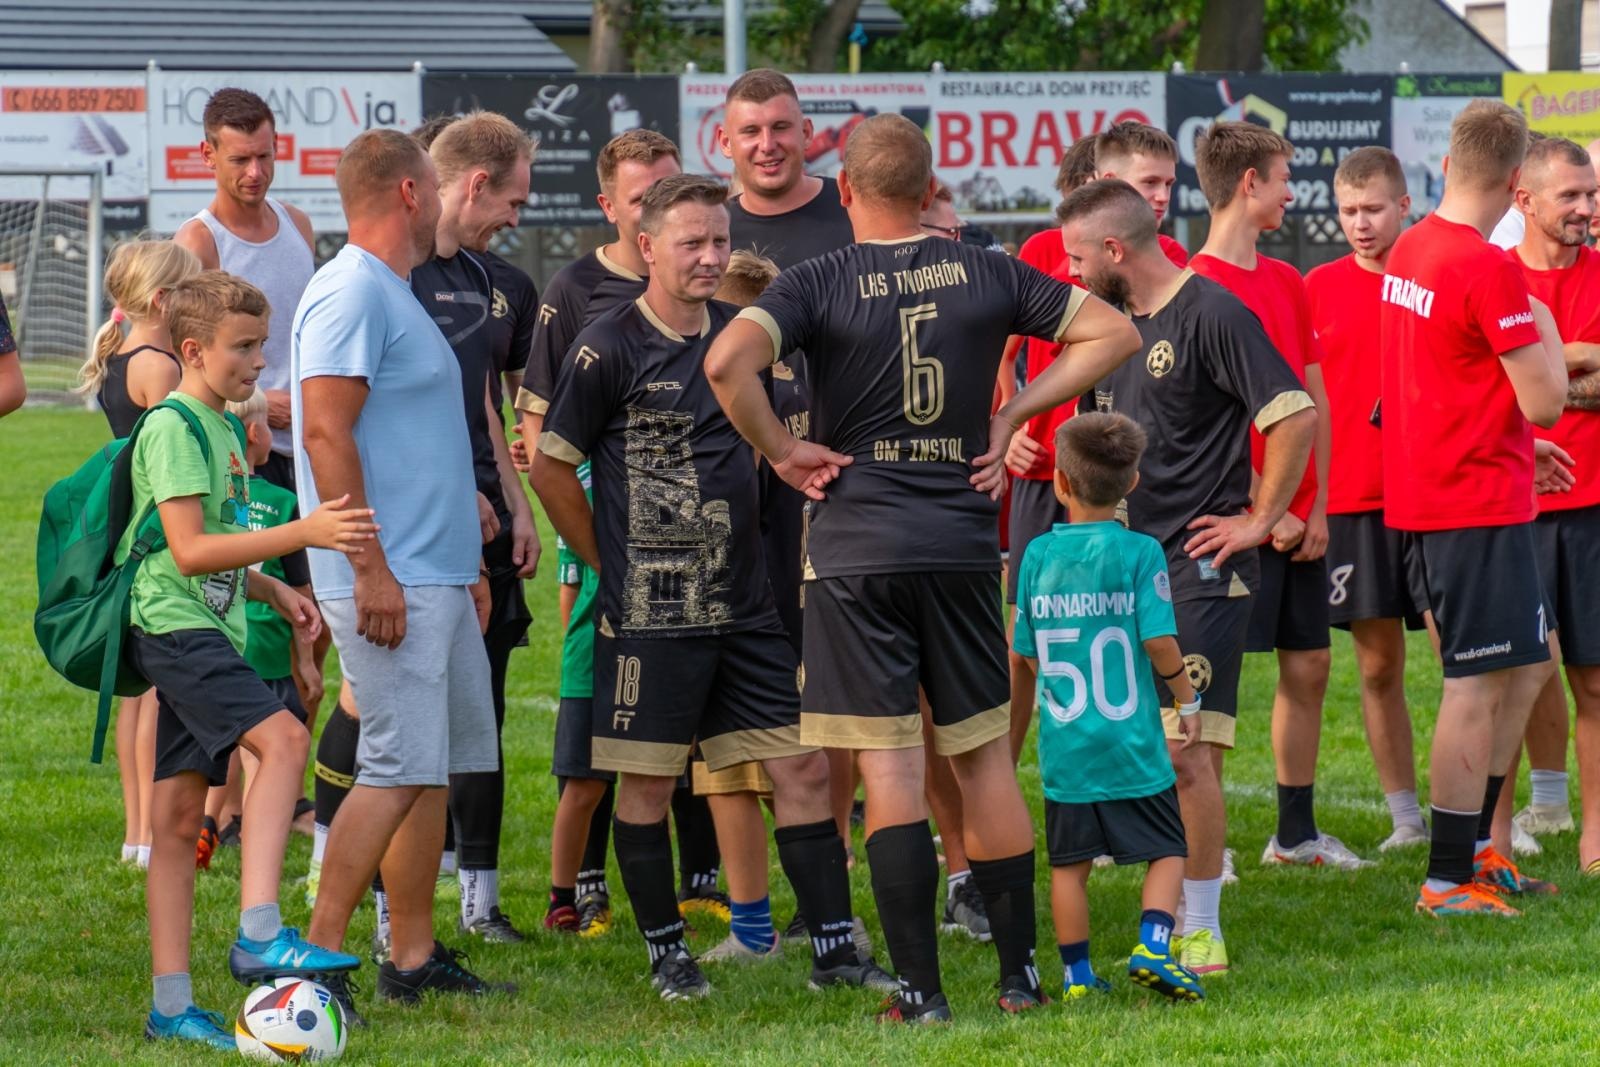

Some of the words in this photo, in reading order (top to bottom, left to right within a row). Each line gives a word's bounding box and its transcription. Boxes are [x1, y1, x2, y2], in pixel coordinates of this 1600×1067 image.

[31, 88, 62, 111] 666
[67, 88, 99, 111] 859
[104, 88, 137, 111] 250
[162, 87, 338, 126] HOAND
[941, 81, 1045, 96] RESTAURACJA
[1050, 82, 1085, 96] DOM
[1090, 78, 1152, 97] PRZYJĘĆ
[936, 110, 1152, 167] BRAV
[1289, 119, 1381, 140] BUDUJEMY
[1320, 145, 1335, 167] A
[1328, 563, 1355, 606] 8
[614, 654, 641, 707] 18
[1034, 626, 1139, 723] 50
